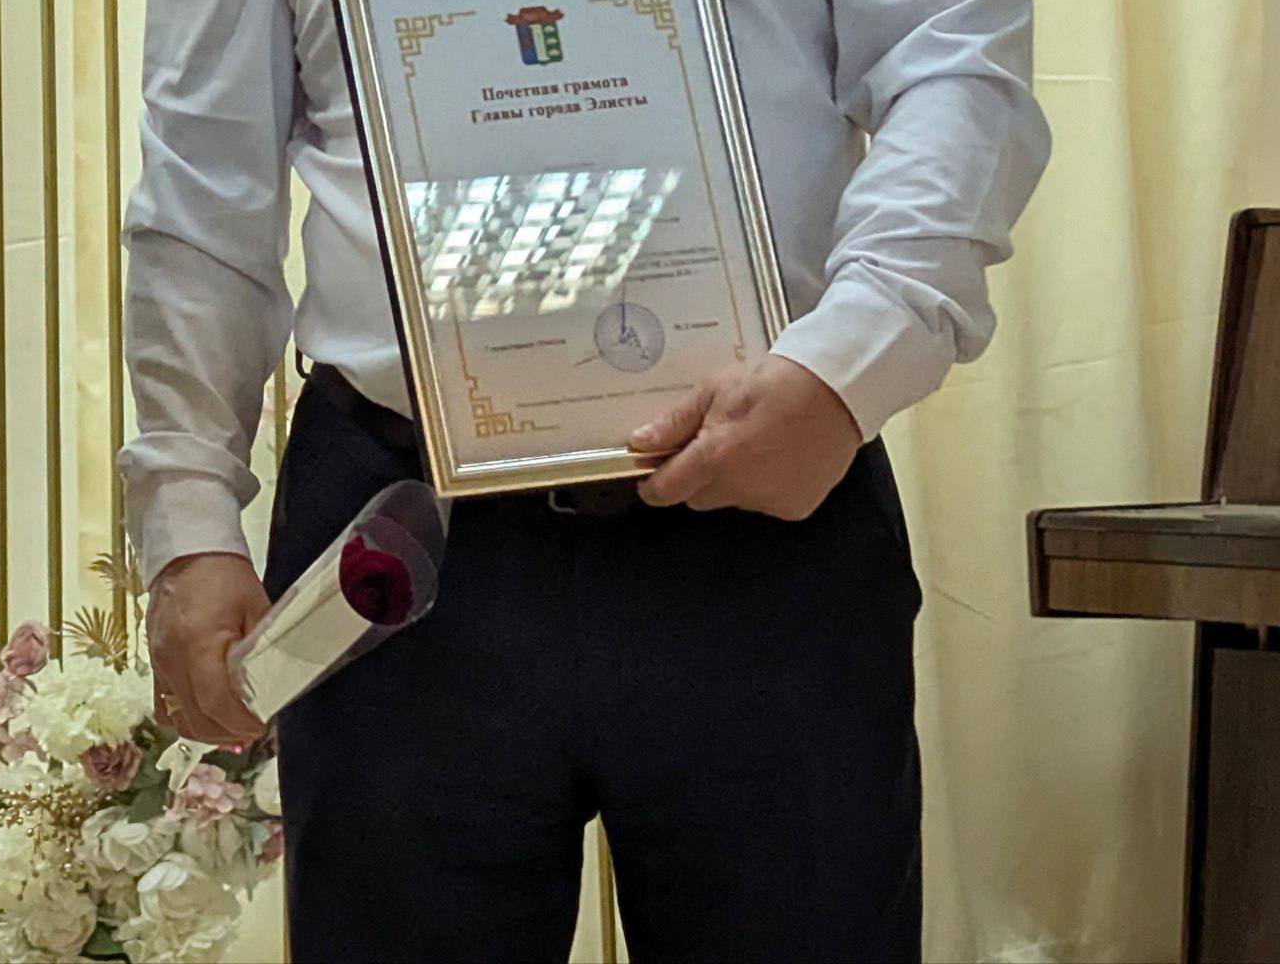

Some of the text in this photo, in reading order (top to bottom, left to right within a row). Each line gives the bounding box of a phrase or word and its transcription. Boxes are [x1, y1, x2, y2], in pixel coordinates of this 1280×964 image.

[481, 76, 629, 102] Почетная грамота
[470, 94, 648, 124] Главы города Элисты
